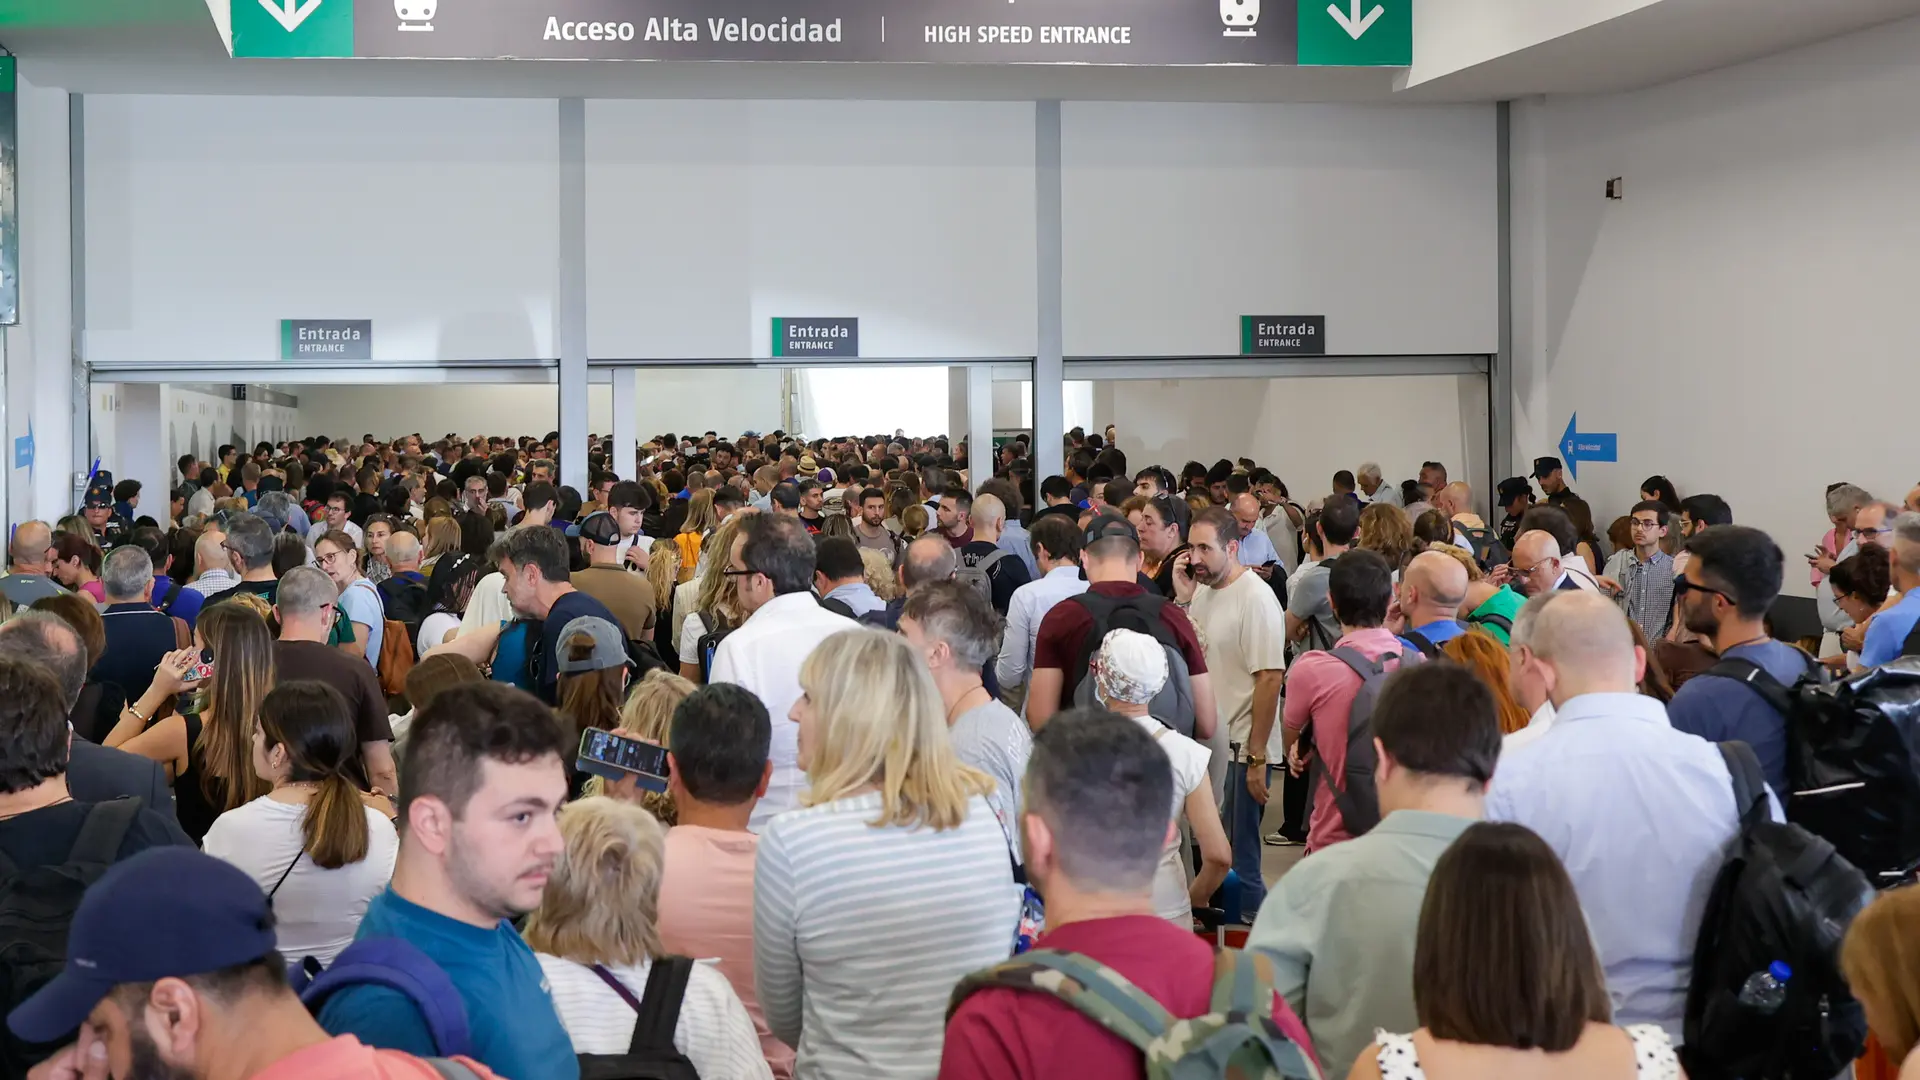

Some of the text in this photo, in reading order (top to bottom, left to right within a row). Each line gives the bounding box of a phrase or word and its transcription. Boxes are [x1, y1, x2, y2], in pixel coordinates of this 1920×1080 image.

[543, 16, 842, 42] Acceso Alta Velocidad
[924, 25, 1131, 45] HIGH SPEED ENTRANCE
[299, 327, 361, 340] Entrada
[789, 325, 848, 338] Entrada
[1258, 323, 1315, 335] Entrada
[299, 344, 345, 352] ENTRANCE
[789, 341, 834, 349] ENTRANCE
[1258, 339, 1301, 347] ENTRANCE
